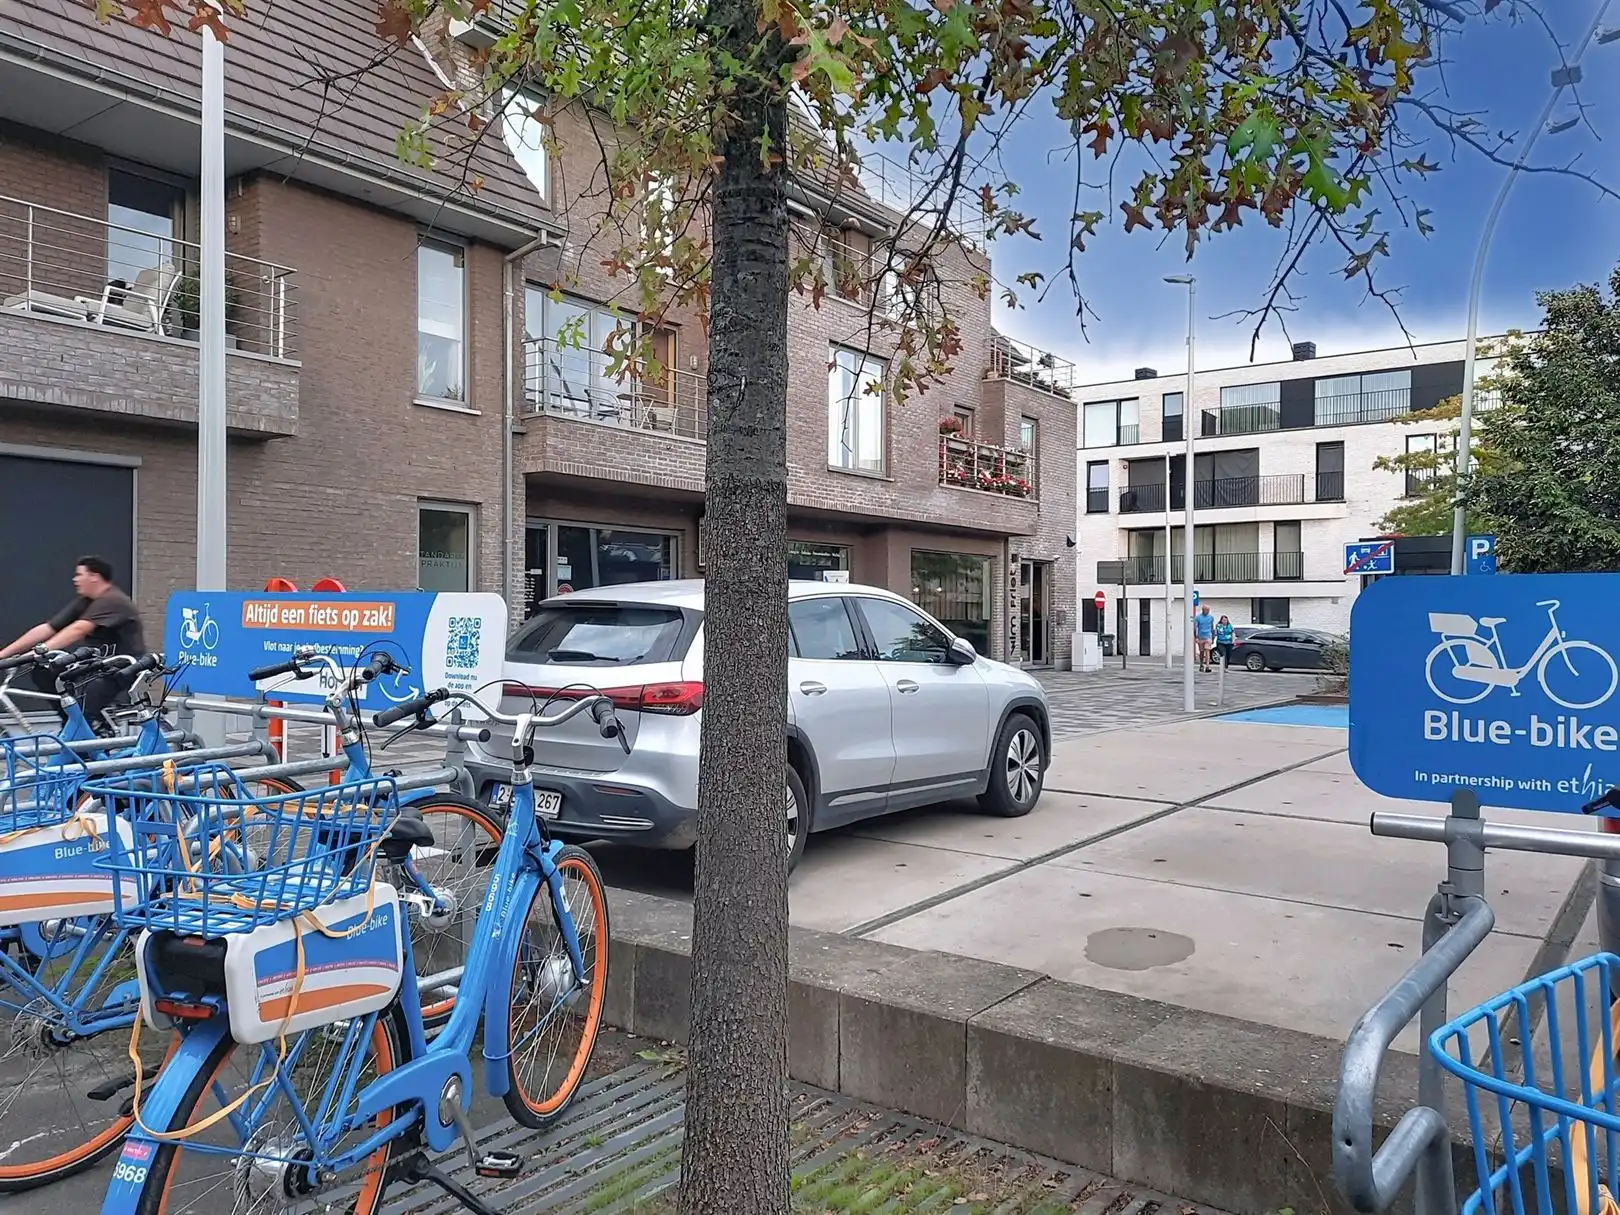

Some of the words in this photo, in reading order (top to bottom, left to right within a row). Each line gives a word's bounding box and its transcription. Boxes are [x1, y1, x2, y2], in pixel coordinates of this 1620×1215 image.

[1472, 539, 1490, 560] P
[245, 603, 278, 628] Altijd
[281, 610, 304, 624] een
[308, 604, 338, 626] fiets
[342, 612, 359, 630] op
[362, 605, 392, 626] zak!
[263, 640, 277, 651] Vlot
[278, 643, 293, 653] naar
[445, 672, 470, 680] Download
[1424, 710, 1618, 751] Blue-bike
[1415, 770, 1428, 782] In
[1431, 772, 1514, 791] partnership
[1518, 777, 1551, 792] with
